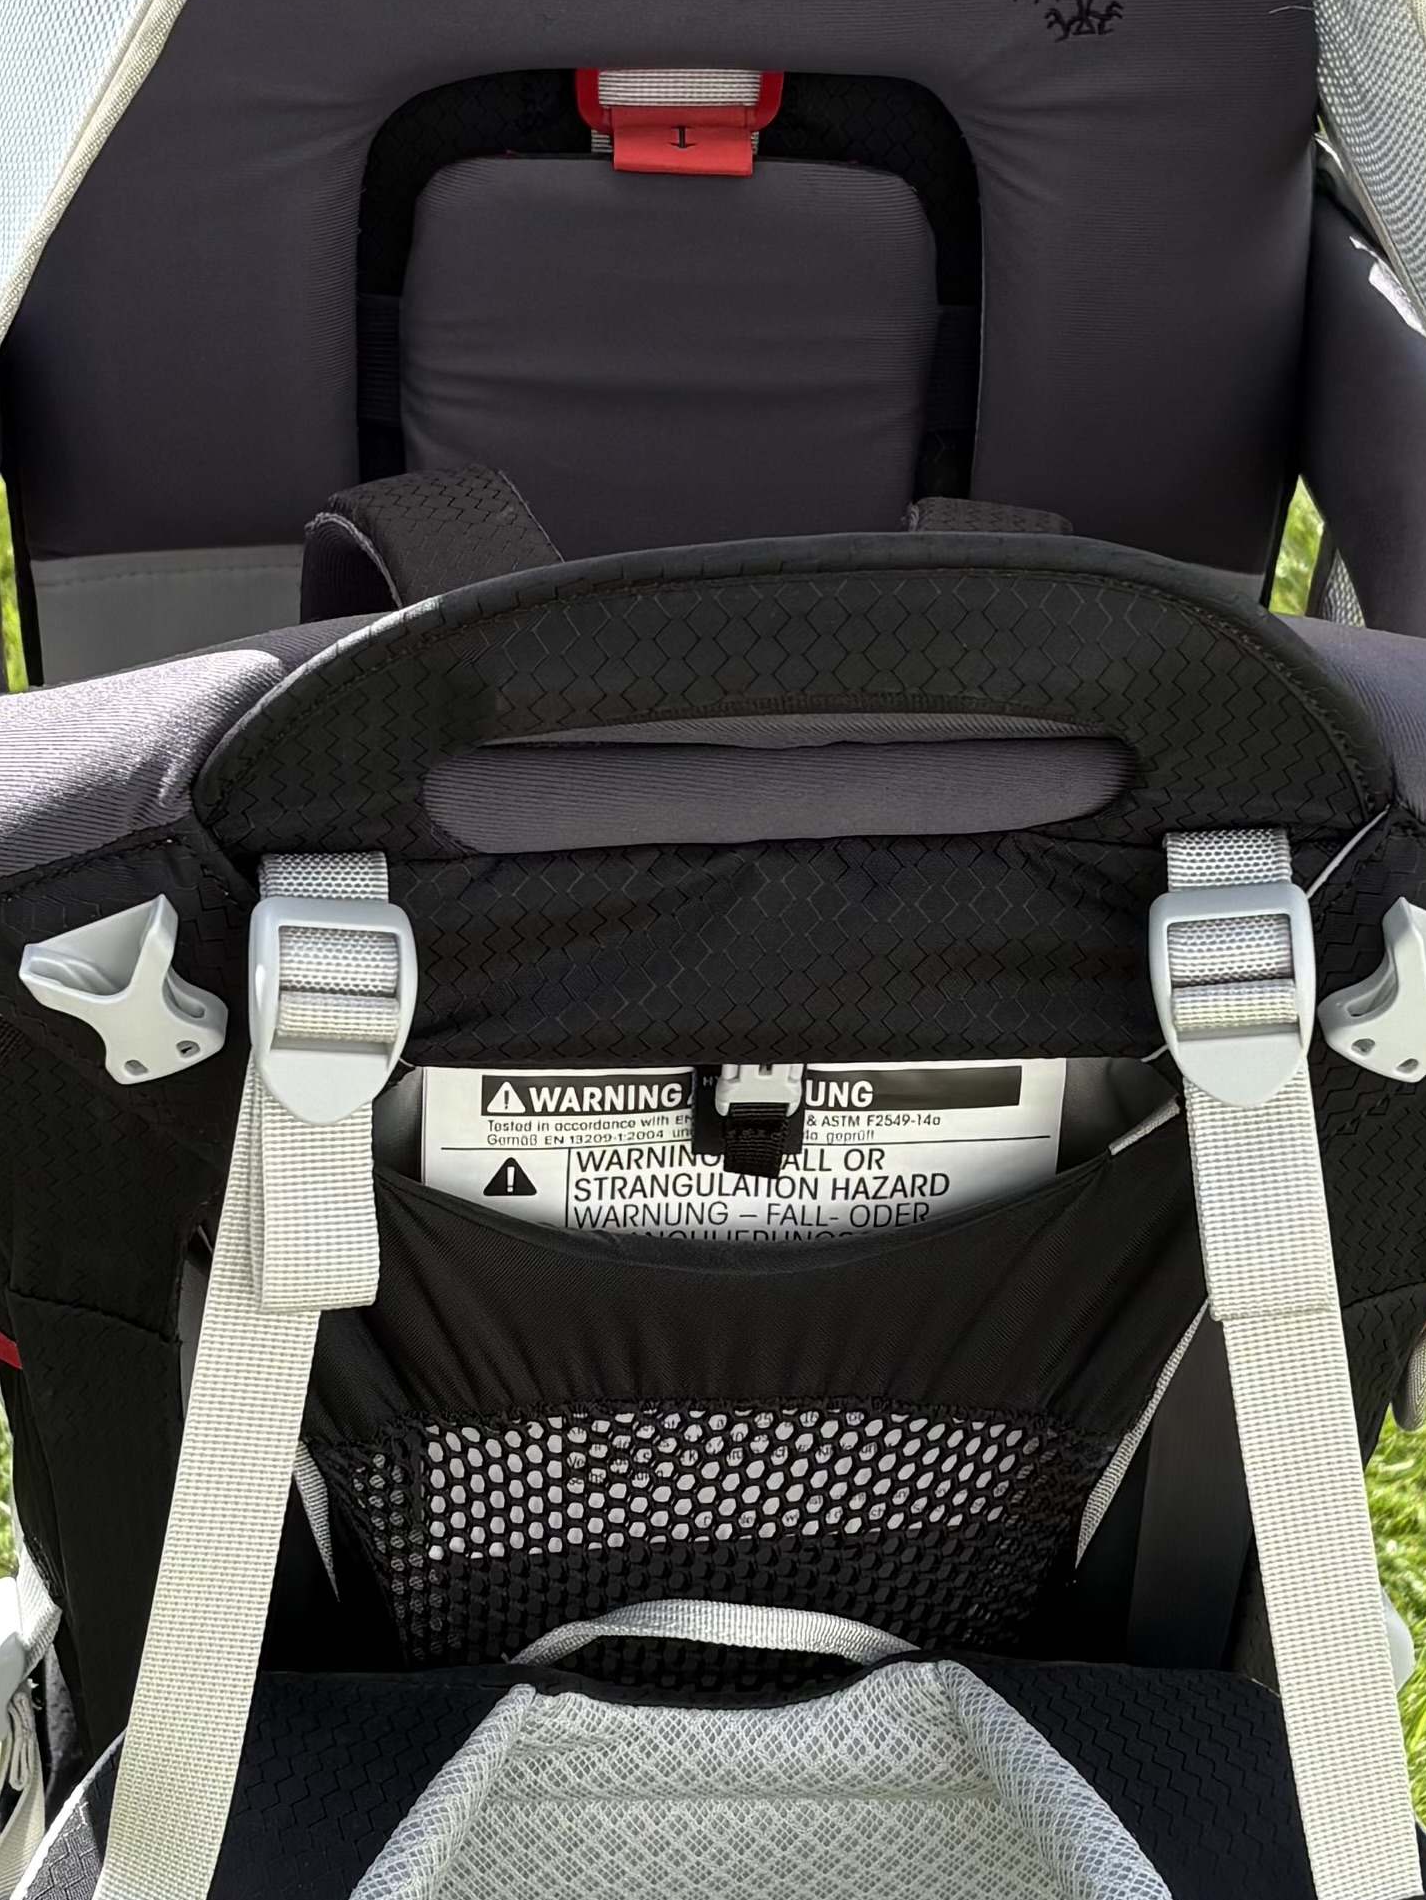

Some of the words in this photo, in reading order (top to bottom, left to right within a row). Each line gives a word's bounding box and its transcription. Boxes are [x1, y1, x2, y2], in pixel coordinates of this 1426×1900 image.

[528, 1082, 683, 1113] WARNING
[487, 1119, 532, 1132] Tested
[537, 1118, 550, 1131] in
[554, 1117, 636, 1131] accordance
[640, 1115, 670, 1127] with
[806, 1115, 817, 1127] &
[821, 1115, 861, 1127] ASTM
[867, 1114, 941, 1127] F2549-14a
[544, 1134, 564, 1145] EN
[672, 1128, 693, 1139] un
[779, 1148, 832, 1171] ALL
[843, 1148, 886, 1171] OR
[831, 1172, 950, 1201] HAZARD
[574, 1201, 729, 1229] WARNUNG
[766, 1202, 839, 1226] FALL-
[849, 1202, 930, 1228] ODER
